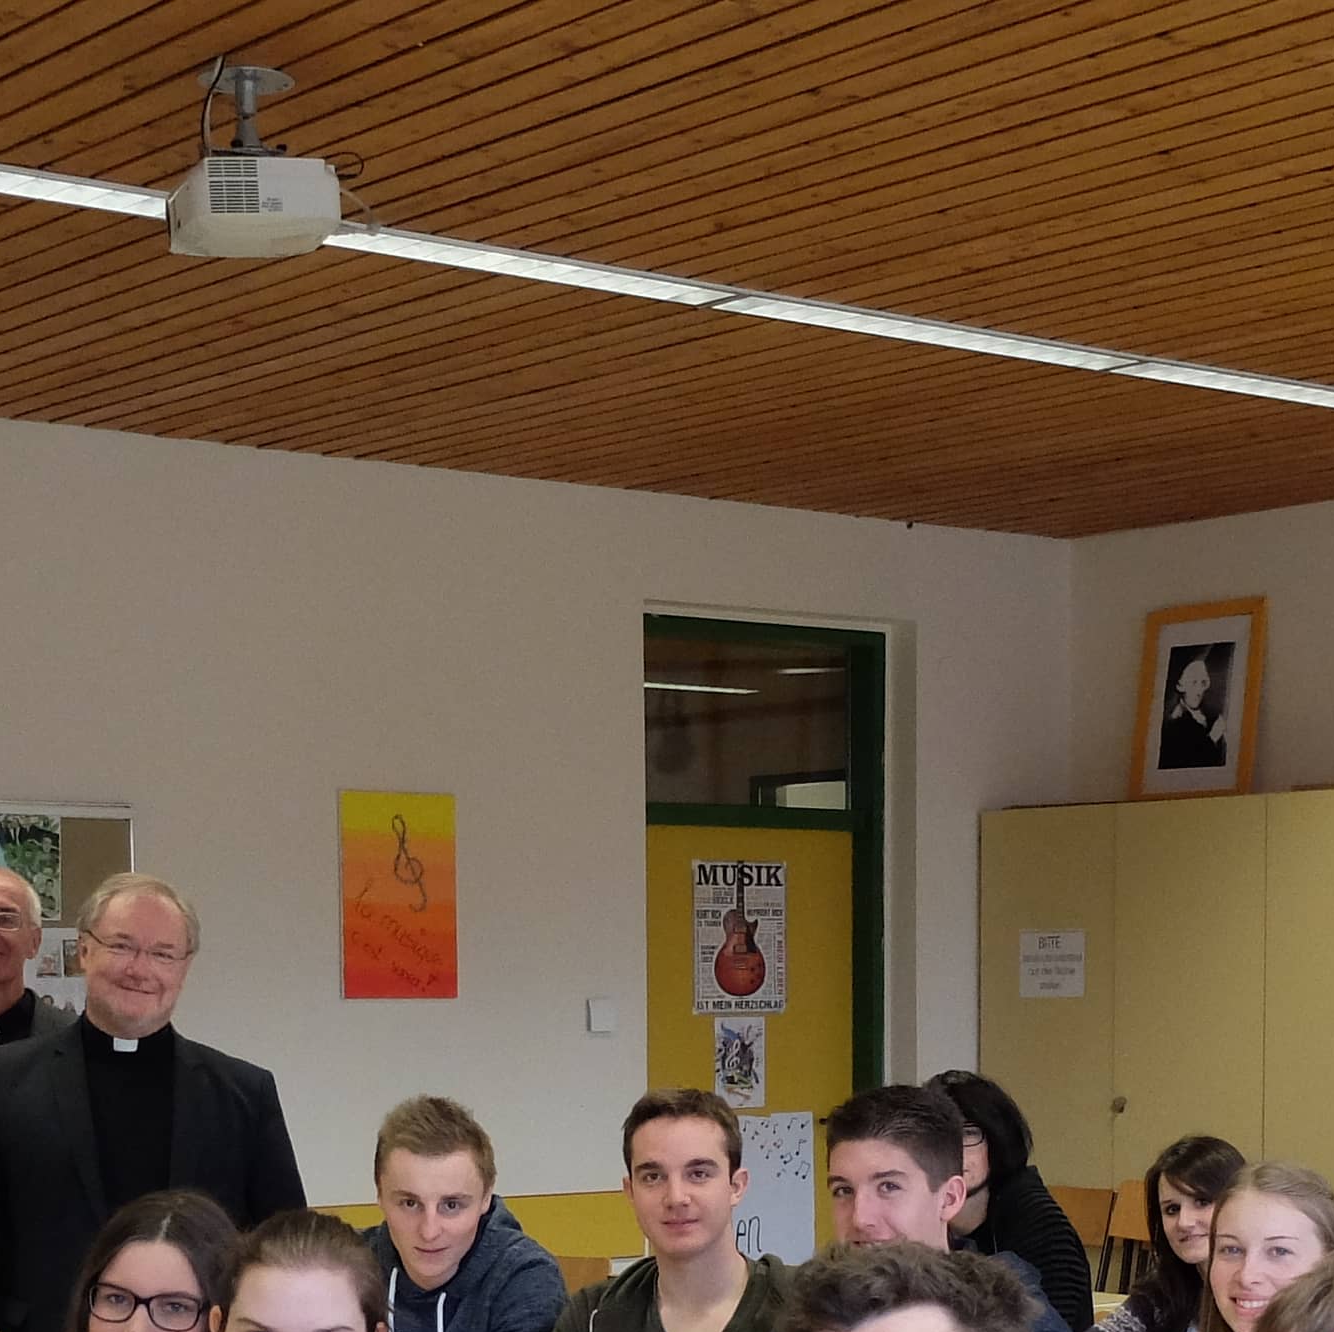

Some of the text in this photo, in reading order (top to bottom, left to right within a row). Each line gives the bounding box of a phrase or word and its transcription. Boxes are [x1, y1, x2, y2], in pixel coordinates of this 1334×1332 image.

[696, 864, 783, 887] MUSIK
[697, 1001, 709, 1010] IST
[712, 1001, 732, 1010] MEIN
